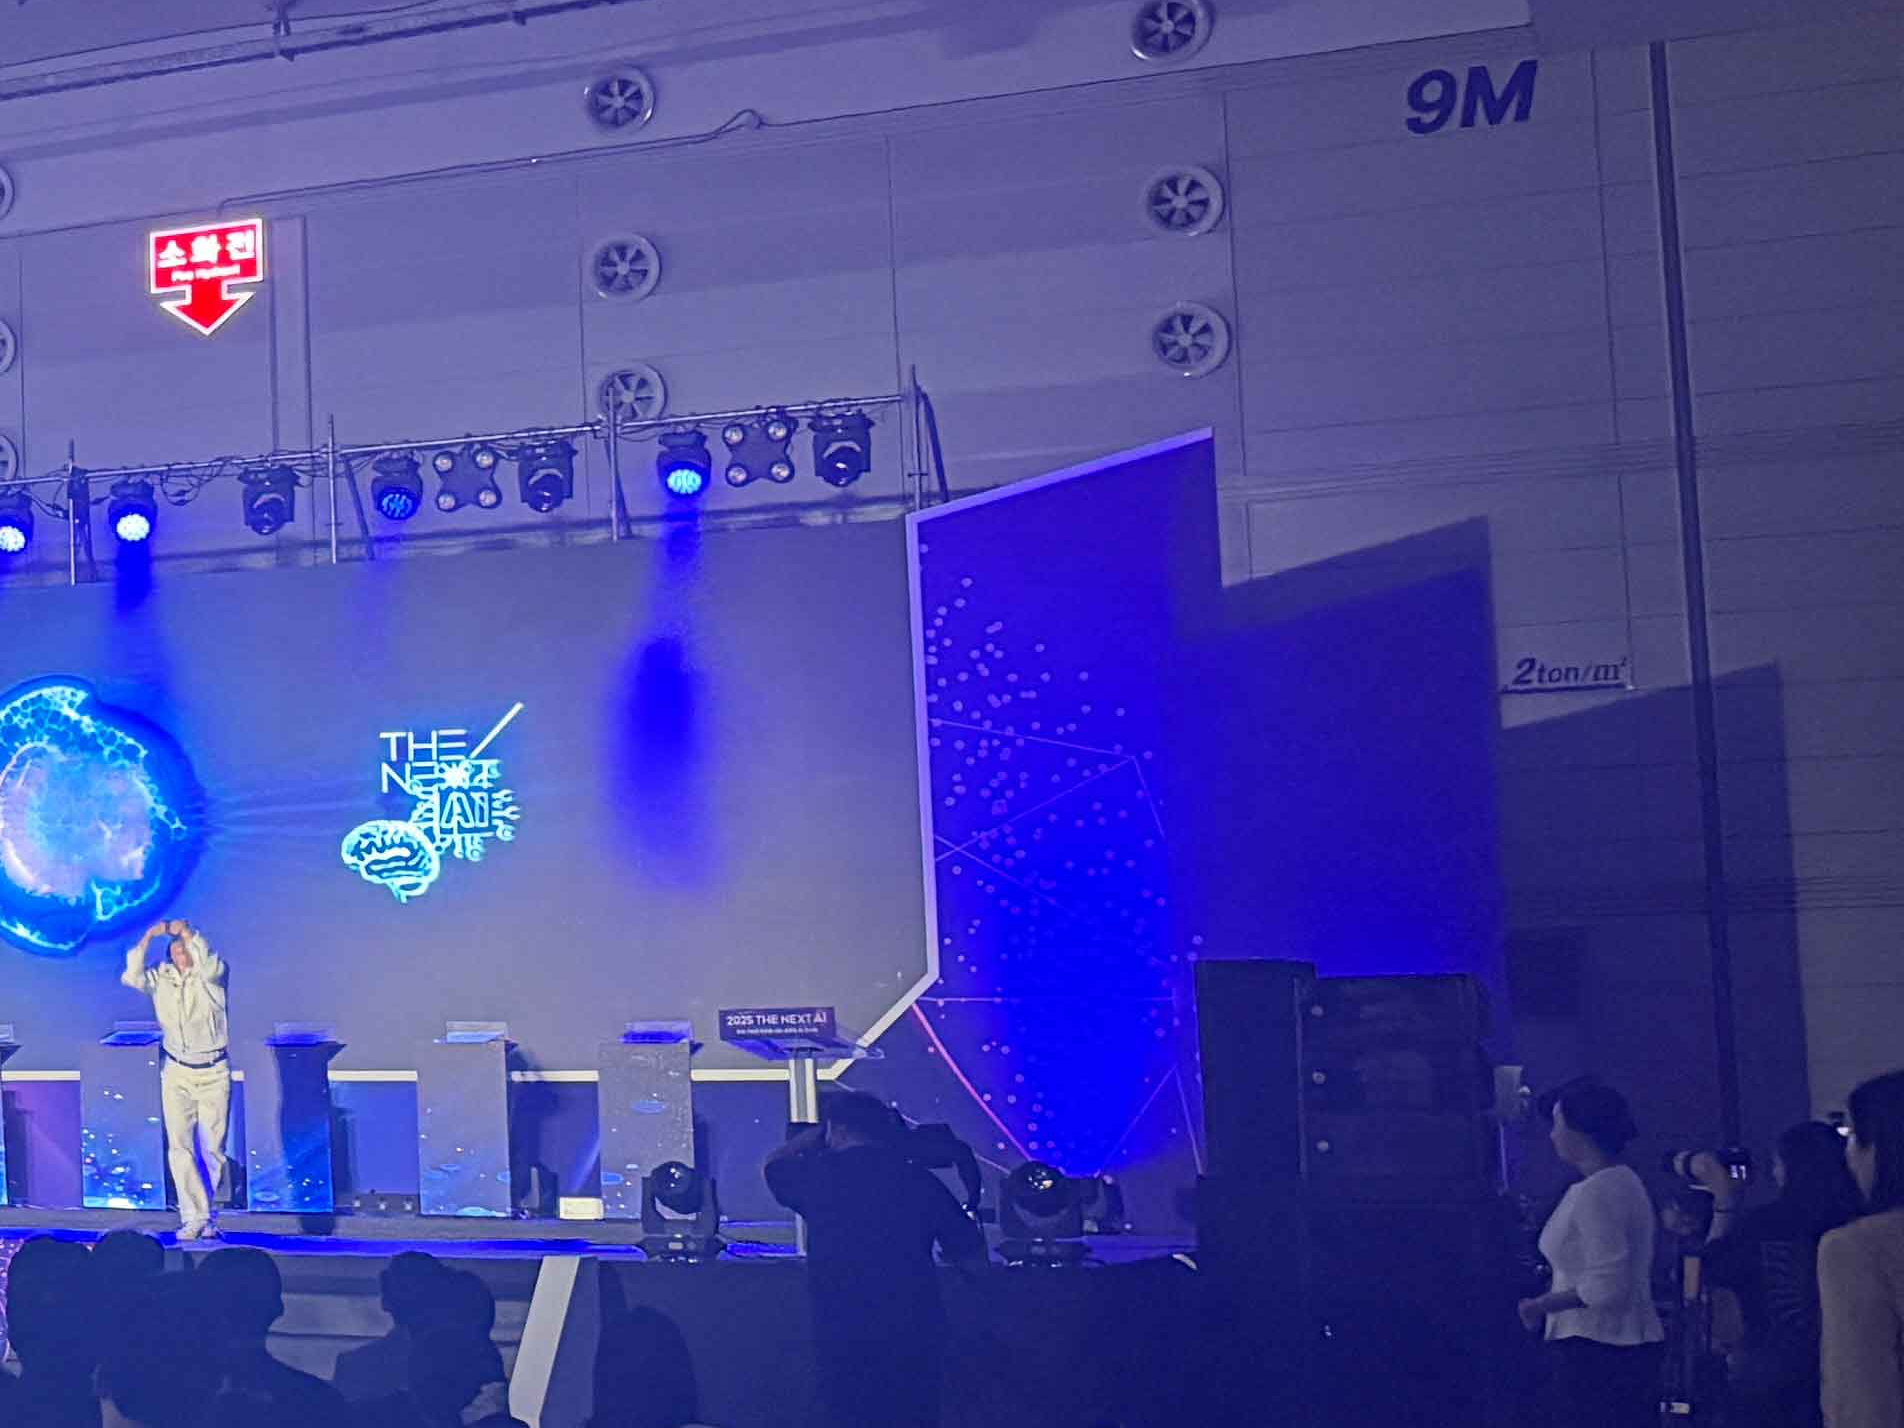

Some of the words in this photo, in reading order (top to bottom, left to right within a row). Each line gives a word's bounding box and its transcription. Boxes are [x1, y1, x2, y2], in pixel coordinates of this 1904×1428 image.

[1405, 59, 1539, 135] 9M
[157, 229, 255, 268] 소화전
[379, 728, 468, 763] THE
[755, 1014, 779, 1026] THE
[780, 1013, 813, 1025] NEXT
